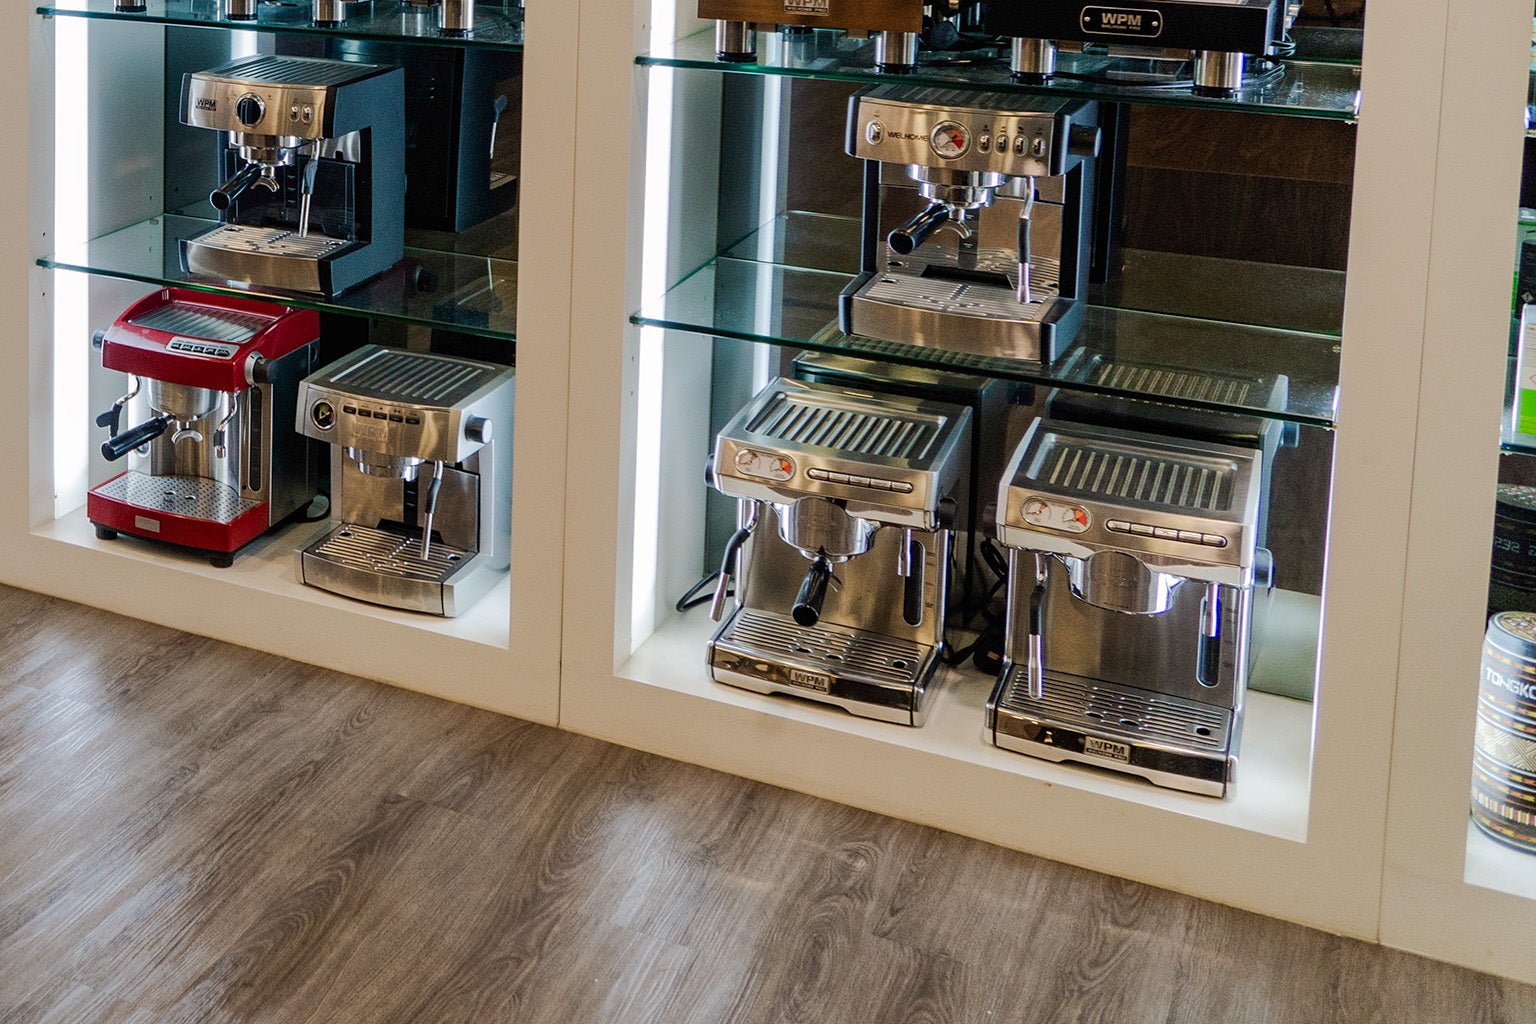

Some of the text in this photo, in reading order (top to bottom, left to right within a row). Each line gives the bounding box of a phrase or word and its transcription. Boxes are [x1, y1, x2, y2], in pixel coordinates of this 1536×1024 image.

[1101, 13, 1142, 26] WPM
[197, 98, 217, 108] WPM
[887, 131, 929, 142] WELHOME
[794, 672, 825, 686] WPM
[1089, 739, 1124, 755] WPM
